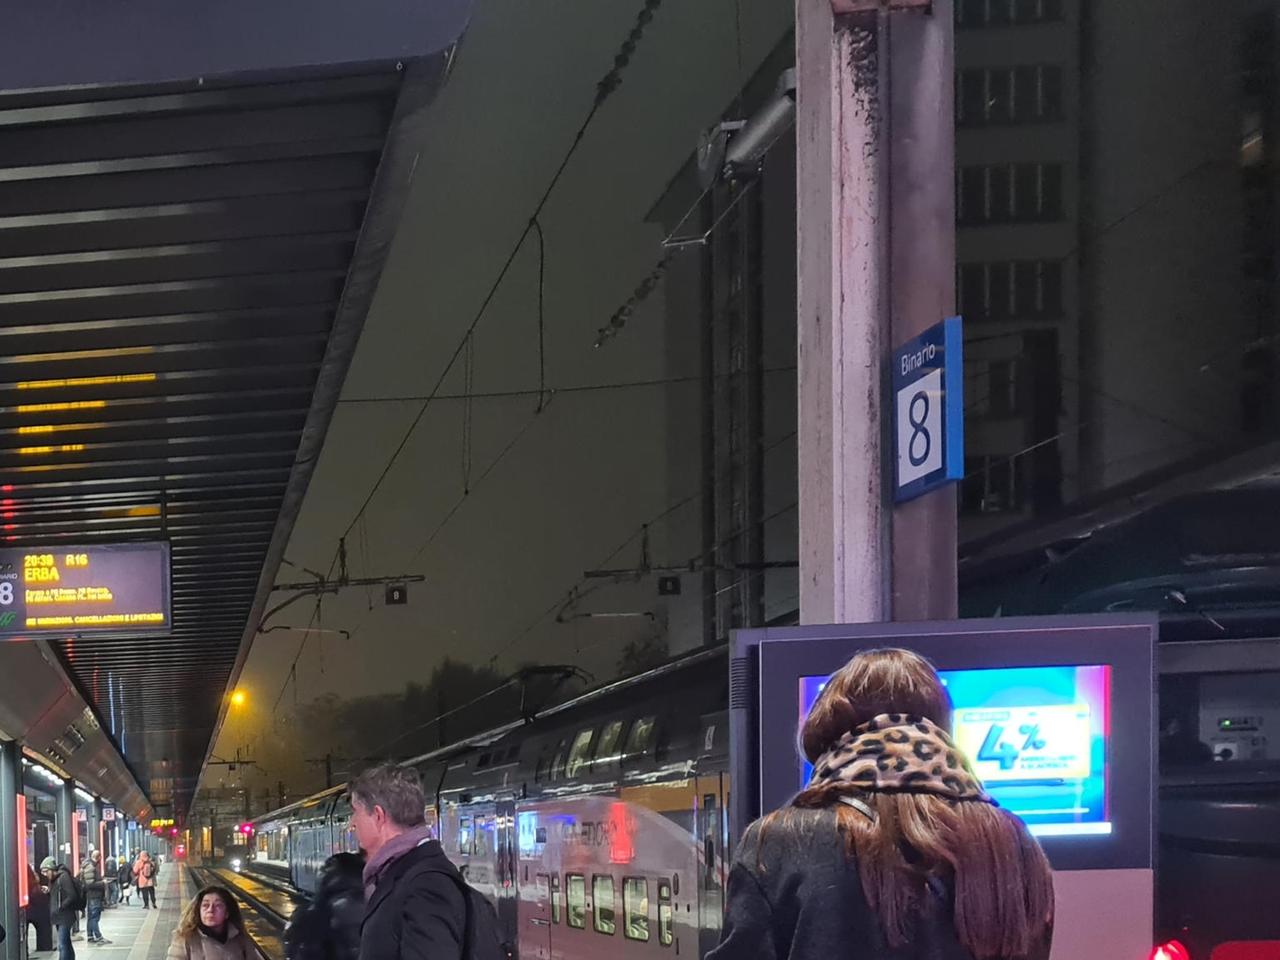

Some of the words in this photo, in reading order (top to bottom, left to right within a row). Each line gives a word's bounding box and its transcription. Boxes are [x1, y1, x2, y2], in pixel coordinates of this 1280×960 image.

[901, 343, 936, 376] Binario
[908, 390, 931, 467] 8
[66, 554, 88, 566] R16
[24, 567, 60, 582] ERBA
